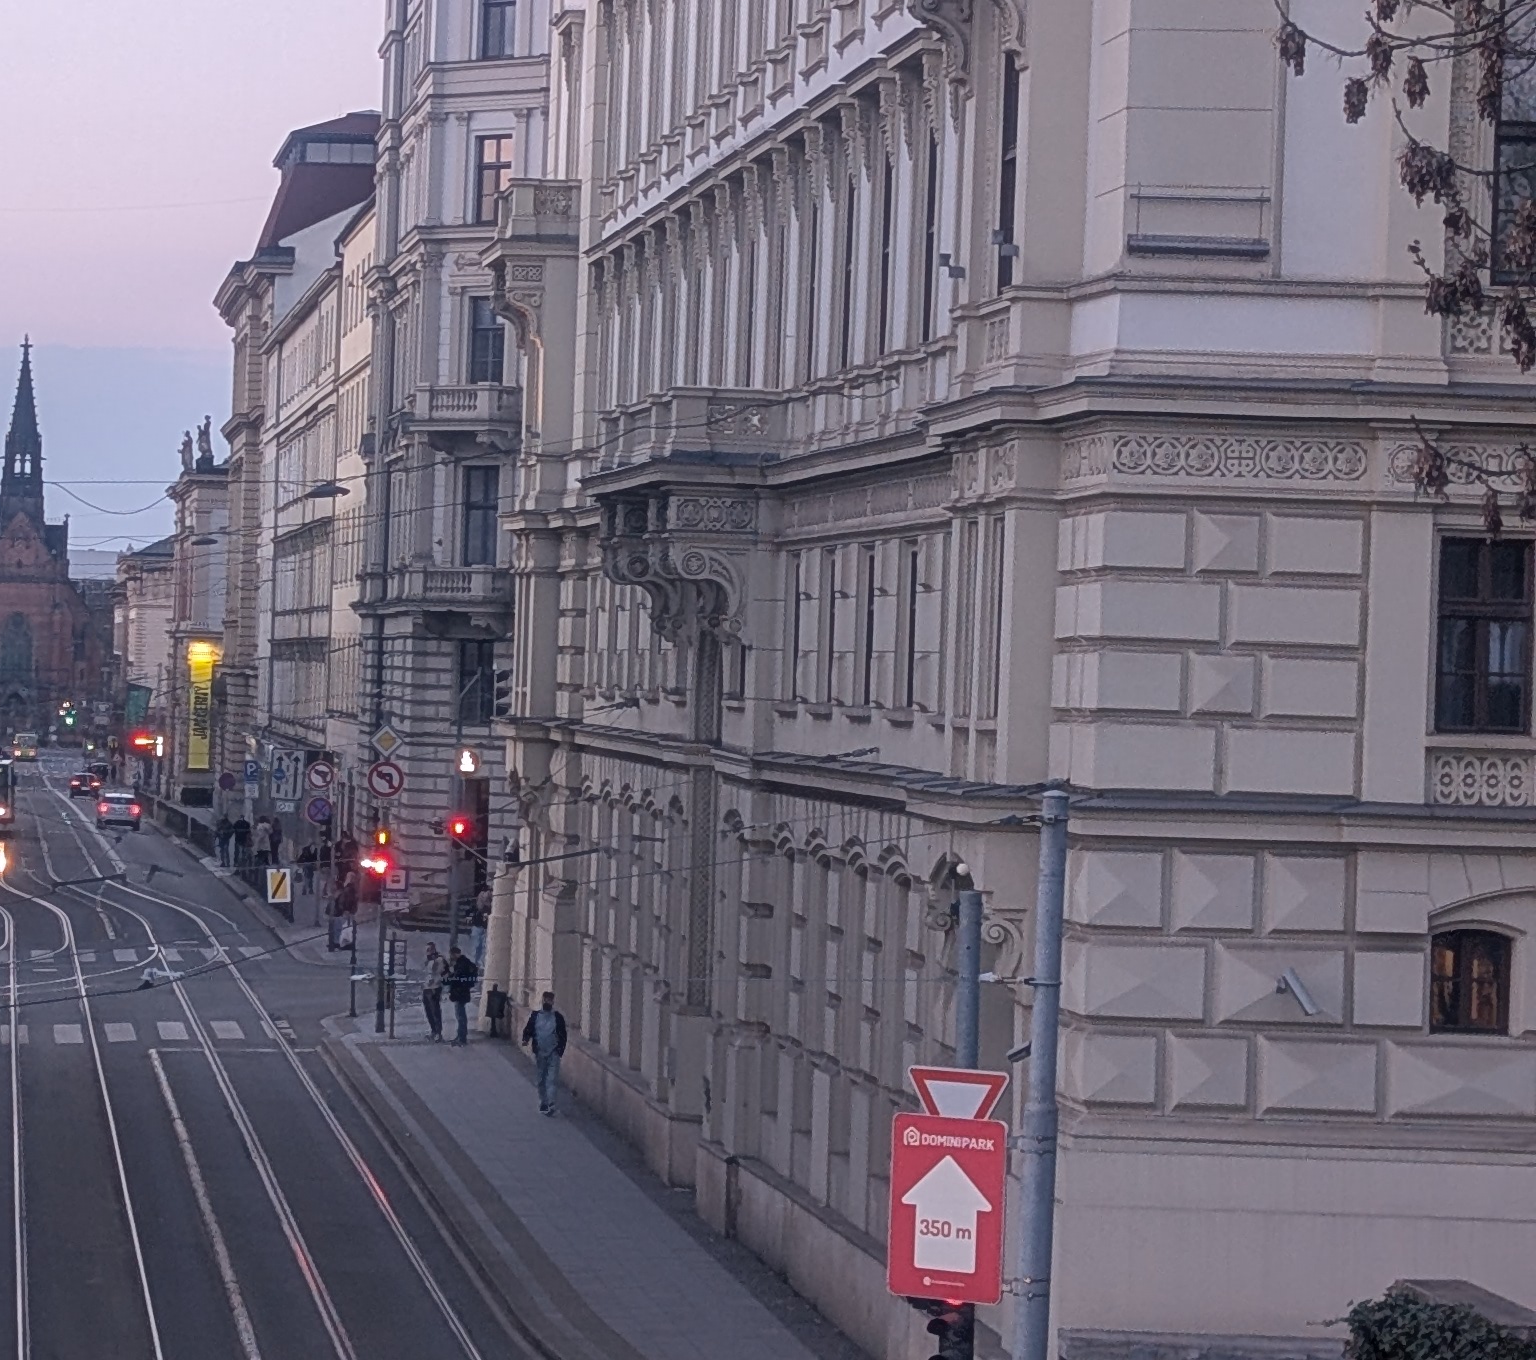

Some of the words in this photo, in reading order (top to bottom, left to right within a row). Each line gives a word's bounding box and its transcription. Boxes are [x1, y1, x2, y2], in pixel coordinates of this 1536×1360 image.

[921, 1133, 995, 1152] DOMINIPARK
[919, 1218, 952, 1238] 350
[955, 1227, 972, 1240] m
